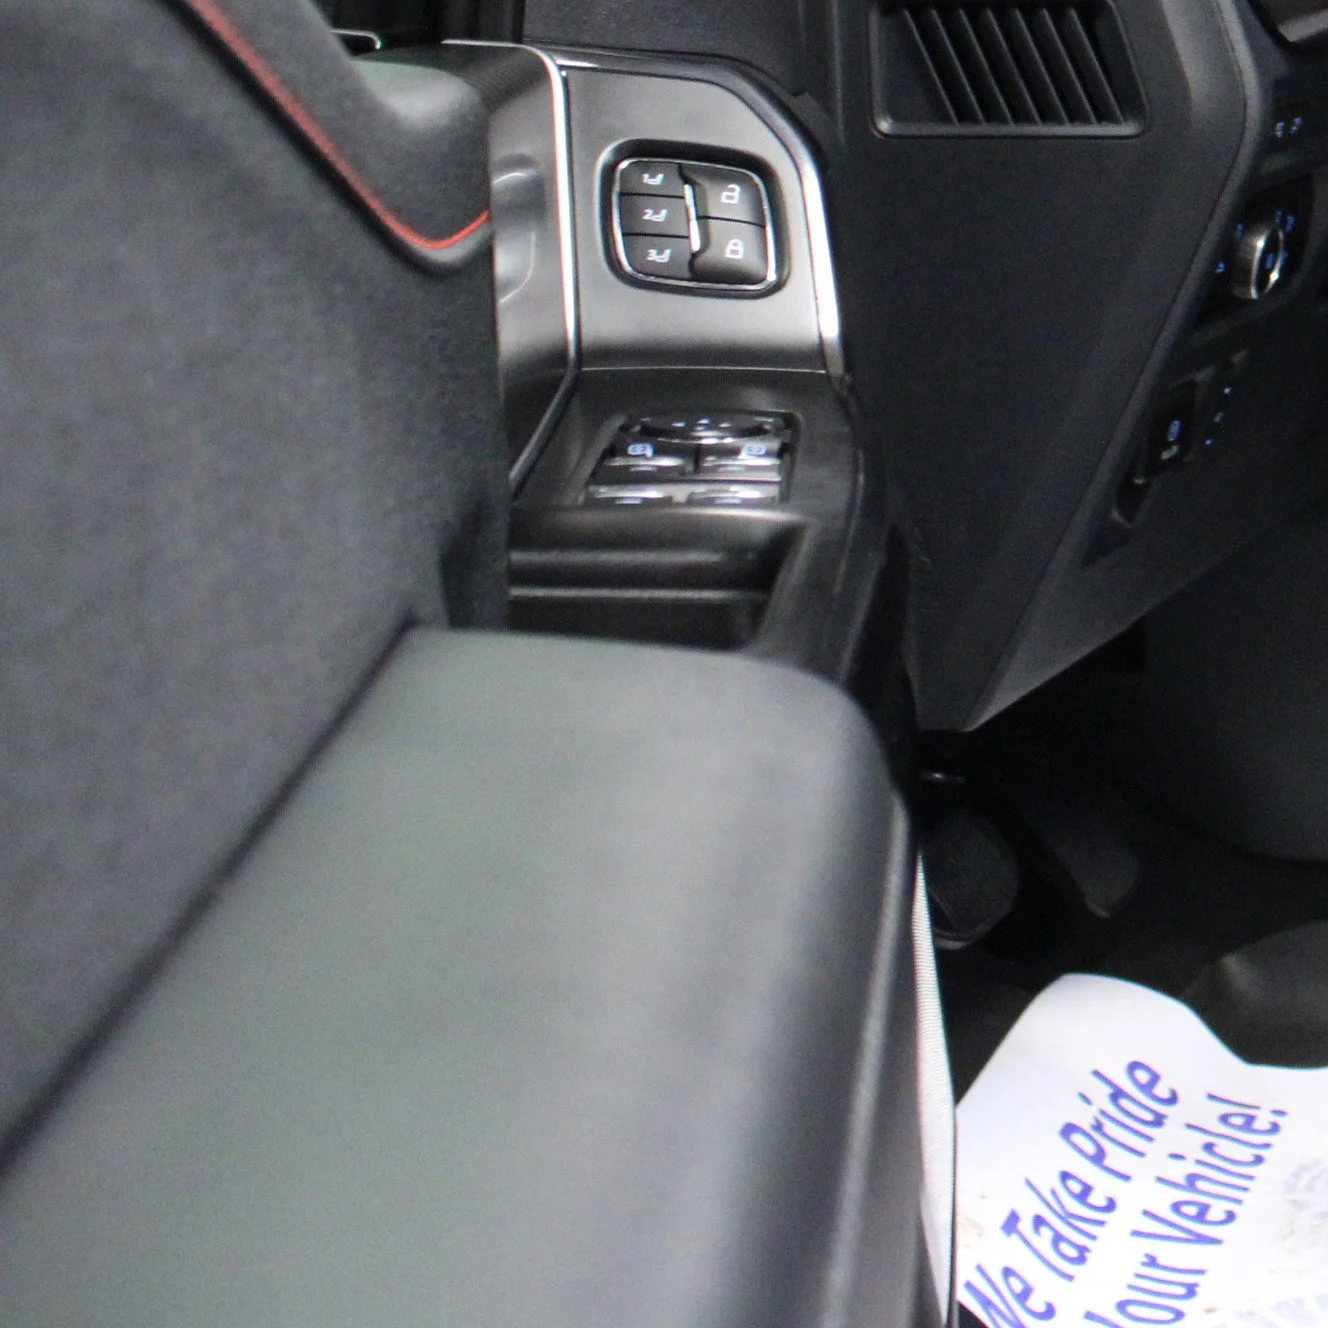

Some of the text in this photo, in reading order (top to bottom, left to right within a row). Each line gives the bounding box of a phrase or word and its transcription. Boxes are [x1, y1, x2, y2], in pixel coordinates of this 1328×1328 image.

[641, 208, 654, 221] 2
[645, 249, 657, 261] 3
[1057, 1060, 1179, 1183] Pride
[1000, 1170, 1118, 1282] Take
[1083, 1091, 1289, 1328] our Vehicle!
